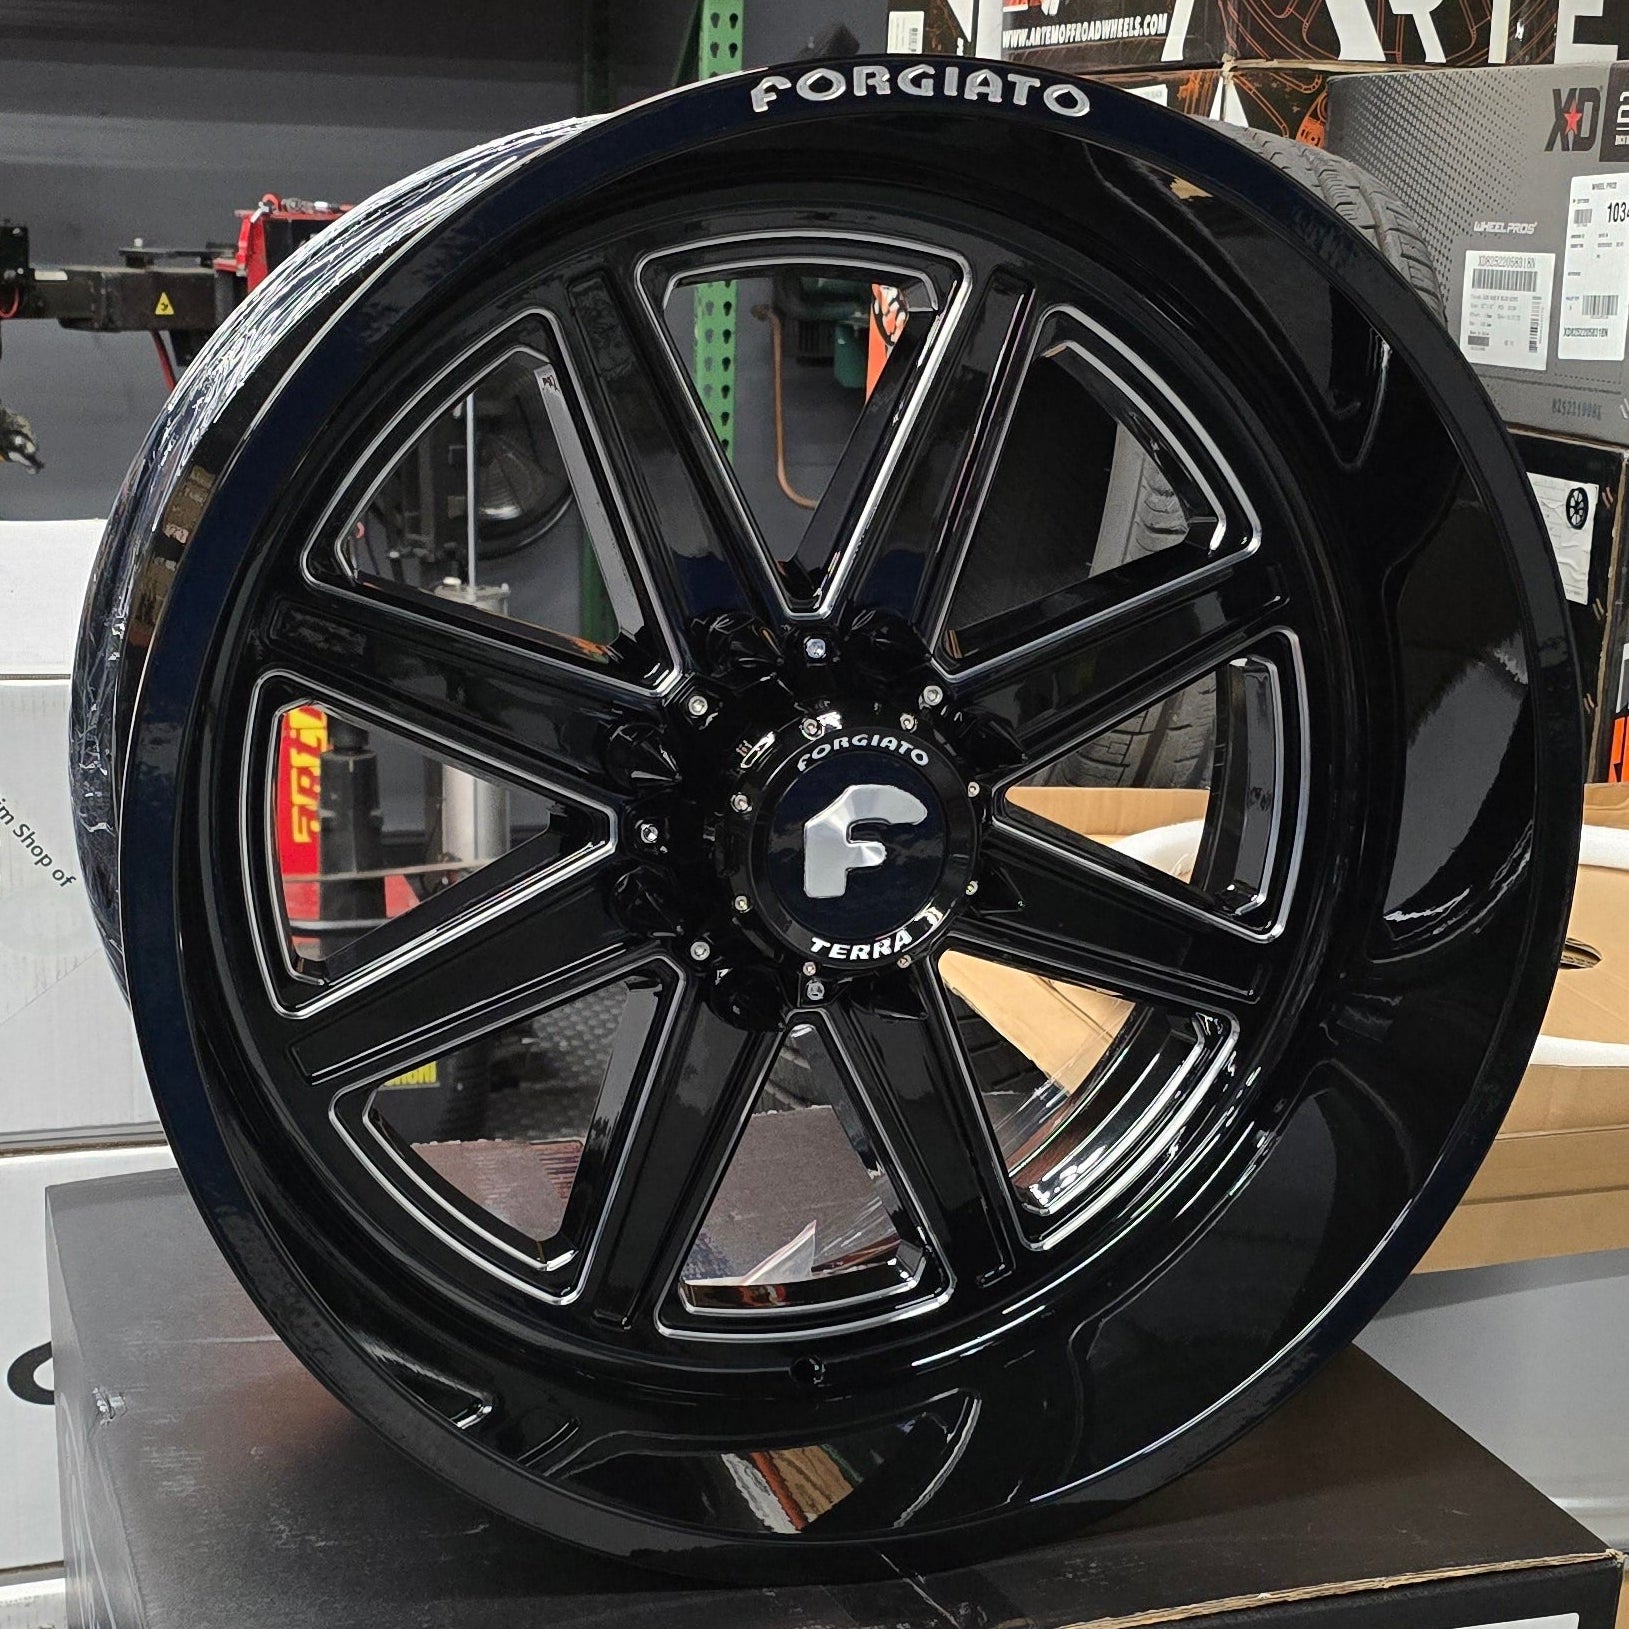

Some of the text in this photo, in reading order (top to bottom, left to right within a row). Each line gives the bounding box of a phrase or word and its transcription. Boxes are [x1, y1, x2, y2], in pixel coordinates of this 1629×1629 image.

[1003, 13, 1168, 49] WWW.ARTEMOFFROADWHEELS.COM
[750, 64, 1090, 117] FORGIATO
[1544, 87, 1601, 152] XD
[797, 734, 929, 772] FORGIATO
[13, 823, 53, 867] Shop
[52, 869, 77, 887] of
[810, 927, 912, 960] TERRA
